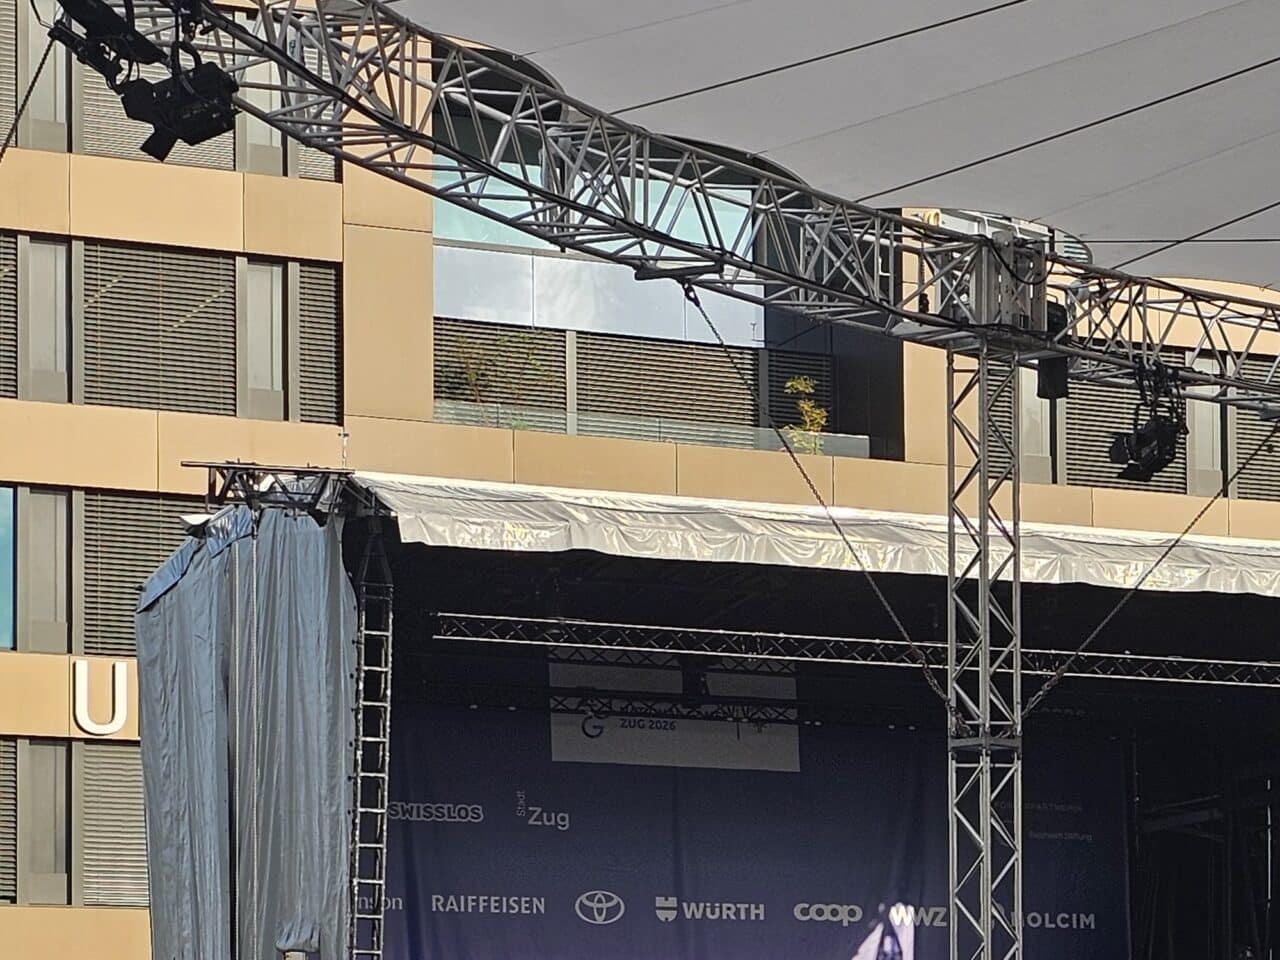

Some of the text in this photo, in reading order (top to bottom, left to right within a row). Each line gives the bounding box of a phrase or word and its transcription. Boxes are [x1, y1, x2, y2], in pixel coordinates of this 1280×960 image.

[388, 802, 484, 823] SWISSLOS
[527, 806, 570, 831] Zug
[431, 894, 545, 915] RAIFFEISEN
[889, 904, 947, 928] WWZ
